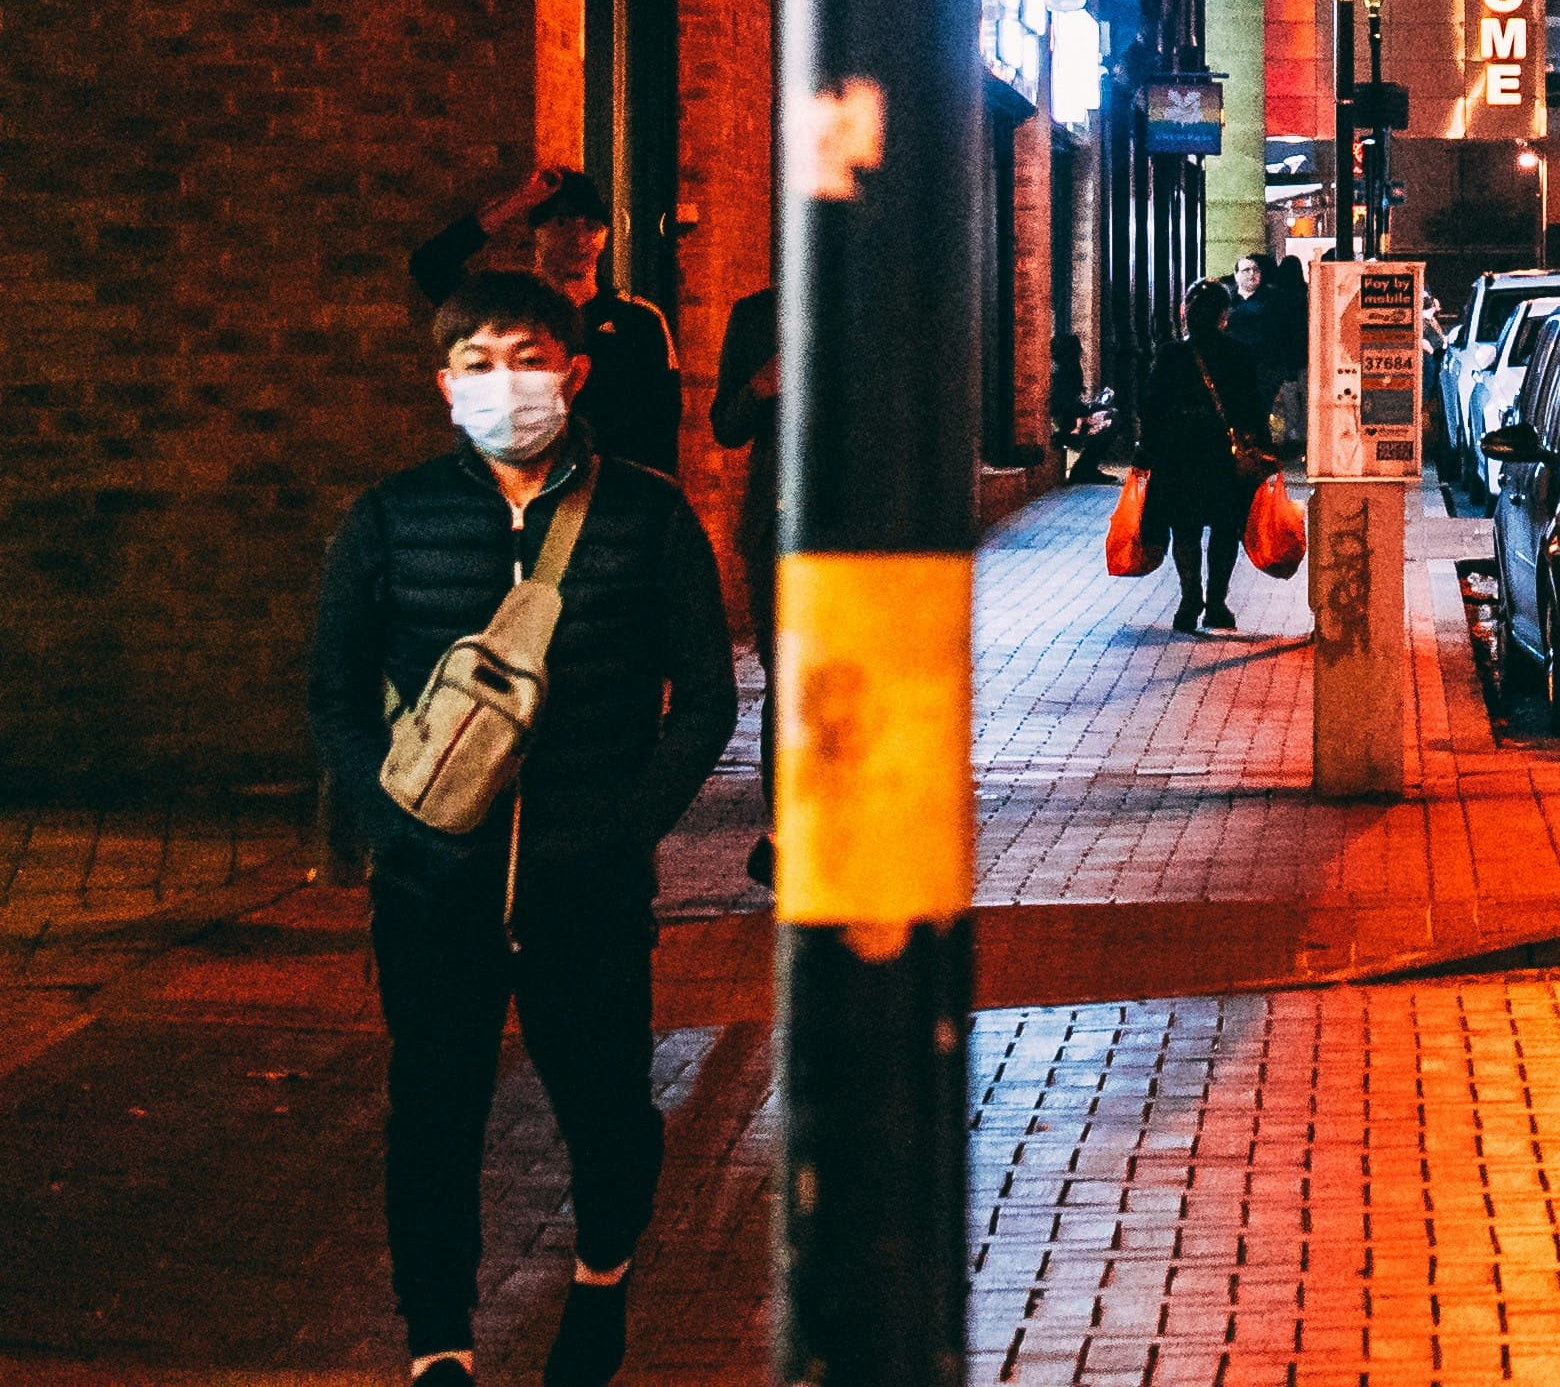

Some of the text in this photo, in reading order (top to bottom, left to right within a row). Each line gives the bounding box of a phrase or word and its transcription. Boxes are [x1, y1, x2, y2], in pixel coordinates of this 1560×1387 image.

[1364, 277, 1410, 292] Pay by
[1364, 292, 1411, 305] mobile
[1364, 356, 1413, 371] 37684
